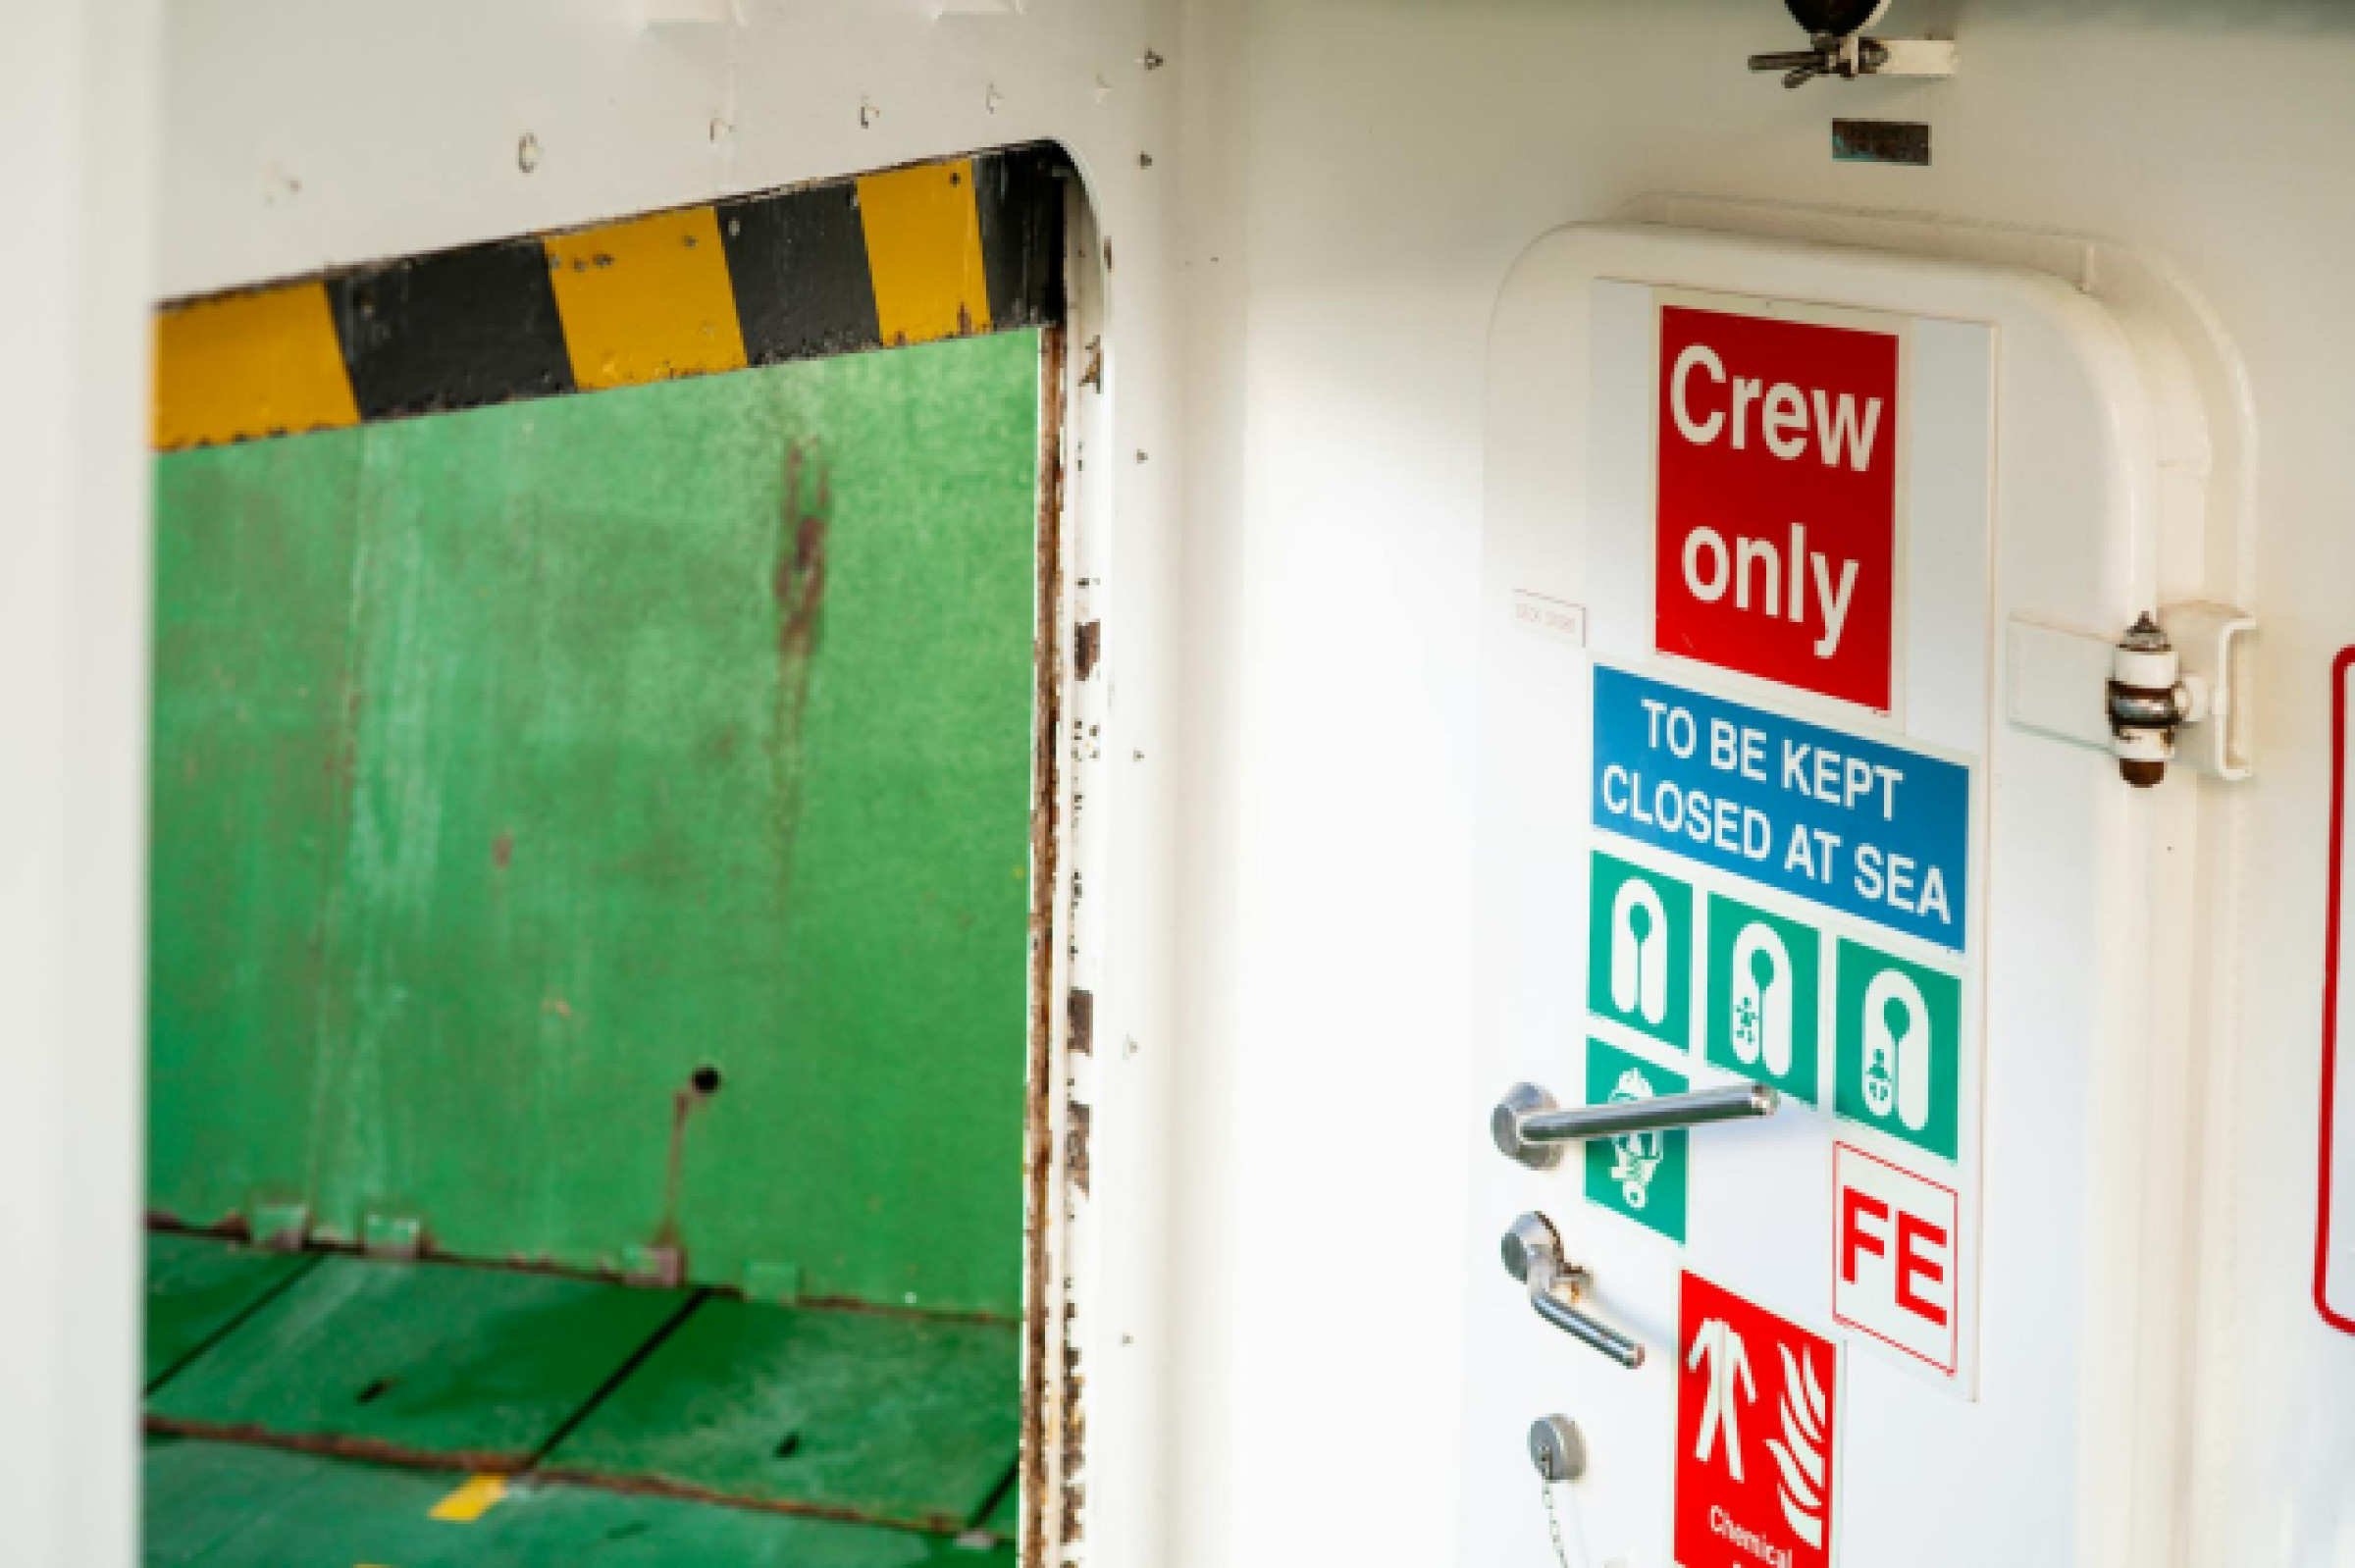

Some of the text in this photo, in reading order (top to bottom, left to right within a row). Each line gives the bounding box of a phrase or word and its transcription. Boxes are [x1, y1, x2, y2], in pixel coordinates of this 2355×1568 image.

[1670, 343, 1882, 473] Crew
[1683, 523, 1860, 659] only
[1640, 699, 1905, 821] TO BE KEPT
[1602, 763, 1952, 924] CLOSED AT SEA
[1842, 1184, 1948, 1327] FE
